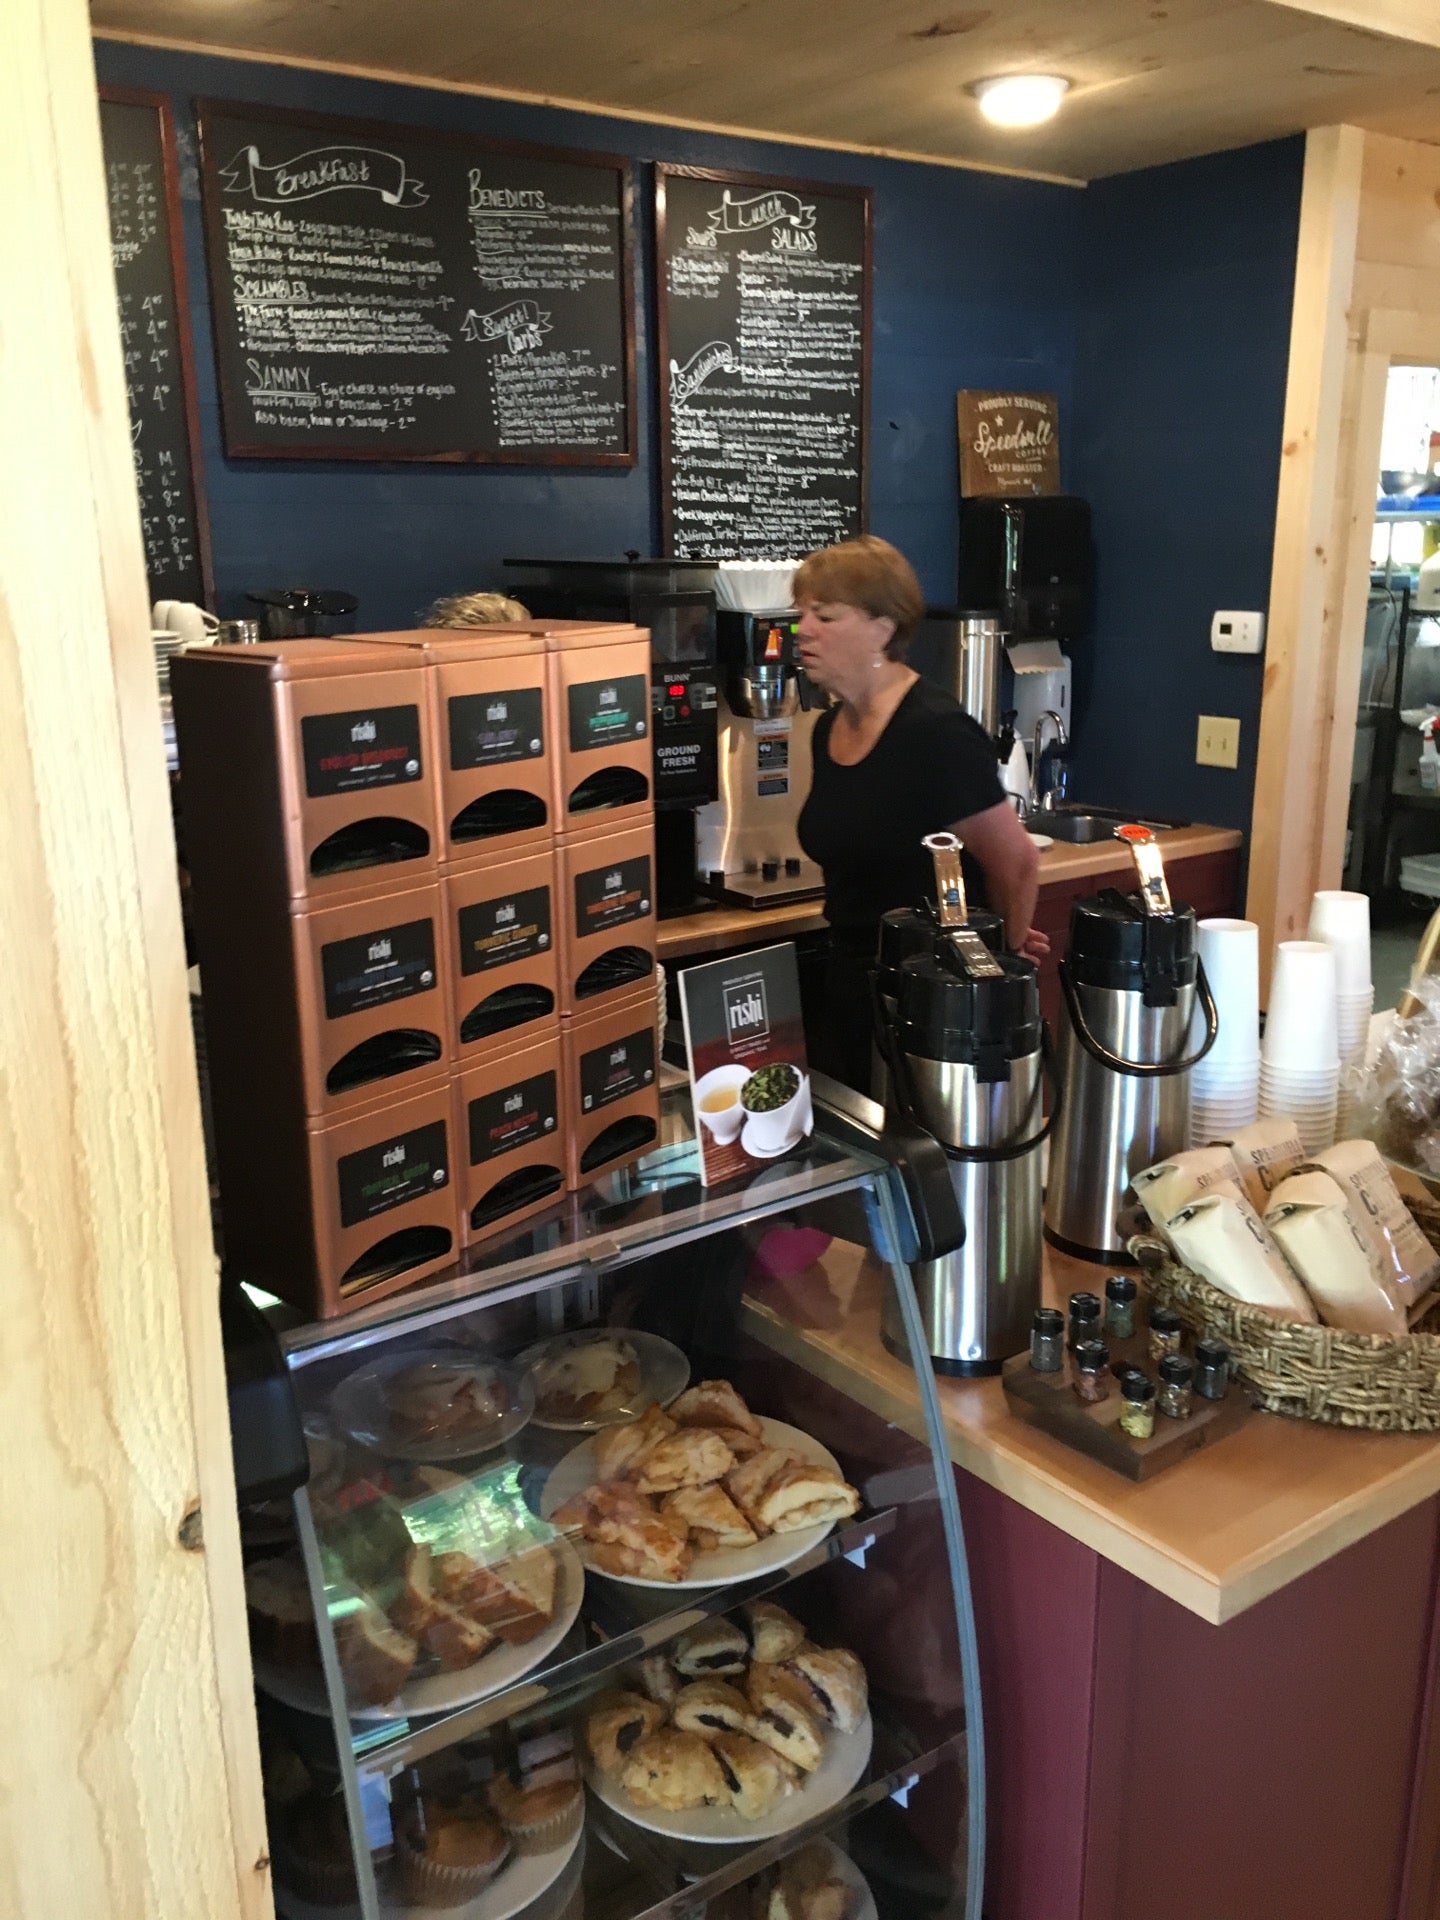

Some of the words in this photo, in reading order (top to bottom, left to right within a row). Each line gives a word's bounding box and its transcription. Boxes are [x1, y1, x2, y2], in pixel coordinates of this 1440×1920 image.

[275, 159, 371, 196] Breakfast
[467, 168, 546, 209] BENEDICTS
[737, 193, 787, 227] Lunch
[771, 226, 818, 252] SALADS
[245, 358, 311, 391] SAMMY
[663, 673, 691, 683] BUNN
[657, 744, 702, 758] GROUND
[662, 755, 697, 769] FRESH
[729, 993, 764, 1029] rishi
